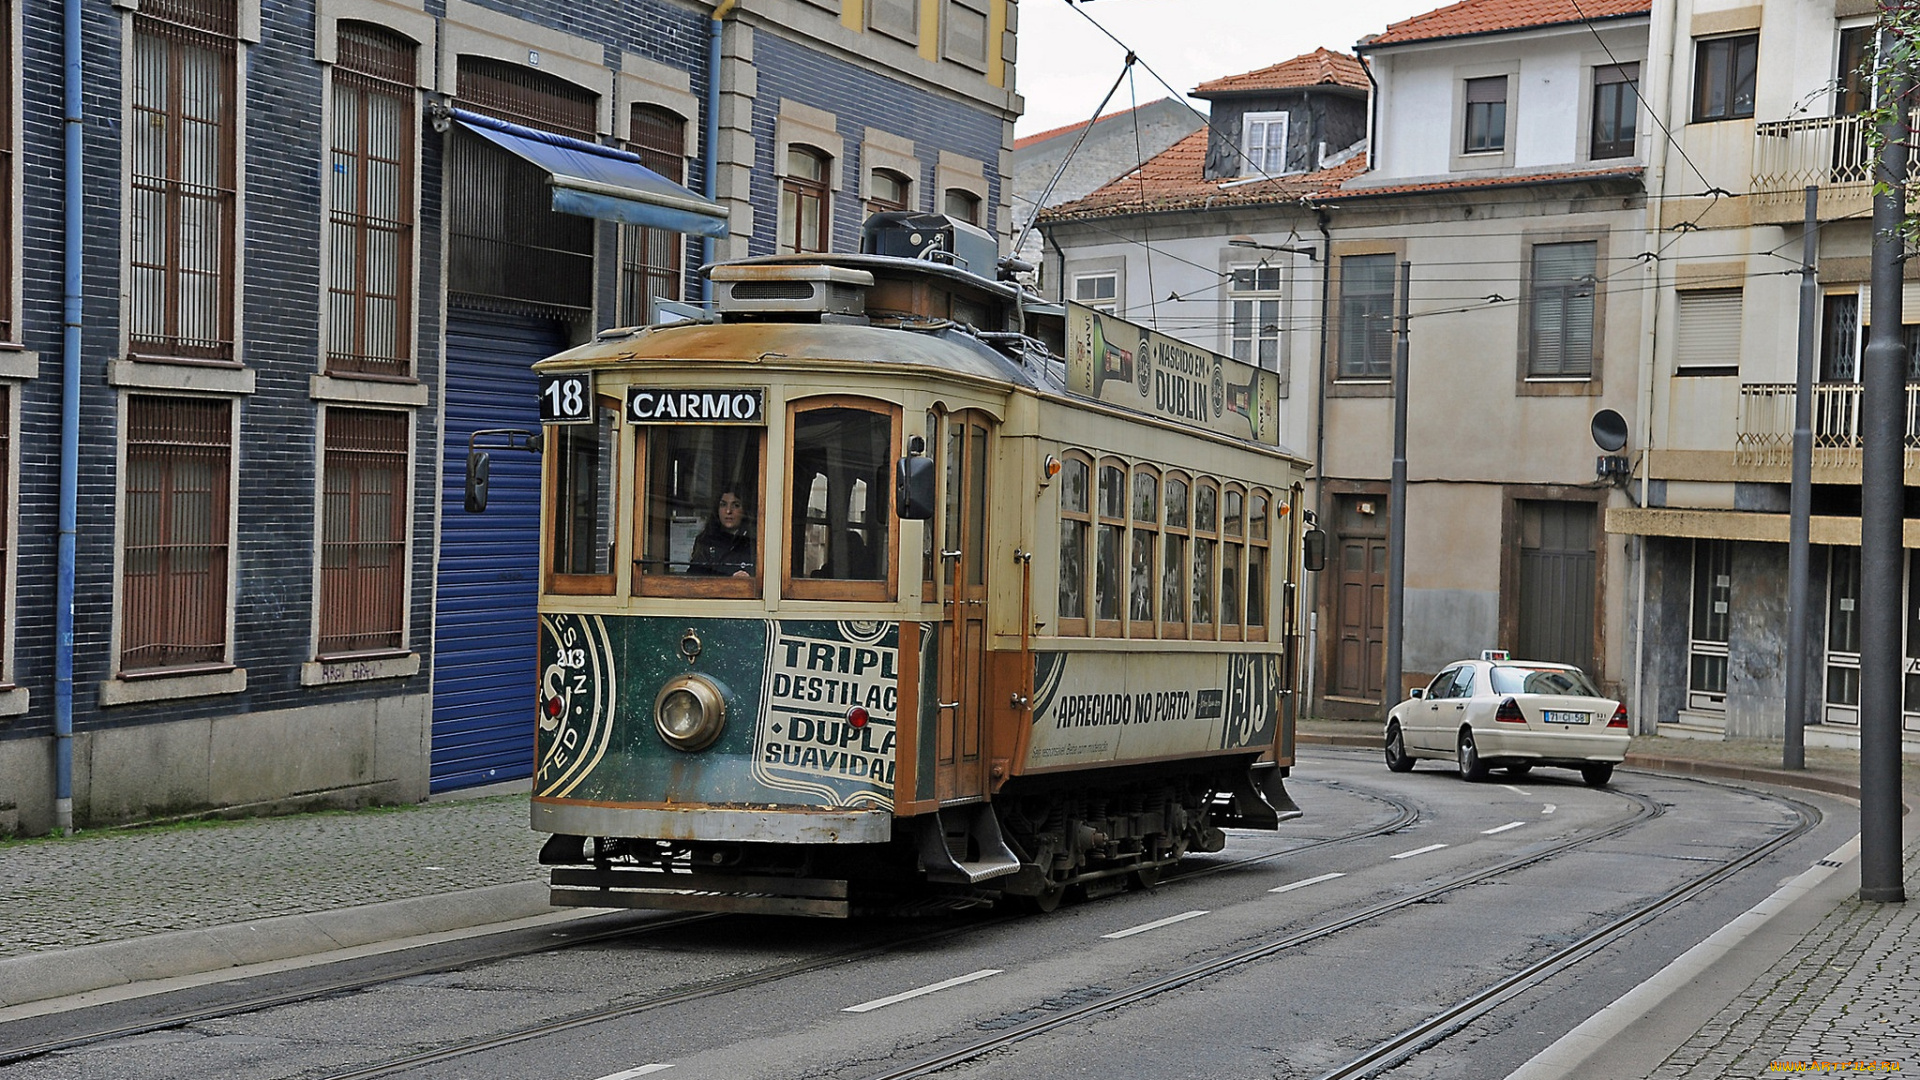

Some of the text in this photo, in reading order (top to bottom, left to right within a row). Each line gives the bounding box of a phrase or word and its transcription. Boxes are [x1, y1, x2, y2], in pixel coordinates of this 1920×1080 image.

[1158, 342, 1206, 379] NASCIDO EM
[544, 379, 584, 417] 18
[632, 392, 756, 419] CARMO
[1155, 368, 1208, 423] DUBLIN
[557, 648, 586, 670] 213
[772, 672, 898, 717] DESTILAÇ
[1057, 693, 1132, 729] APRECIADO
[1134, 691, 1152, 725] NO
[1154, 690, 1190, 722] PORTO
[788, 716, 897, 755] DUPLA
